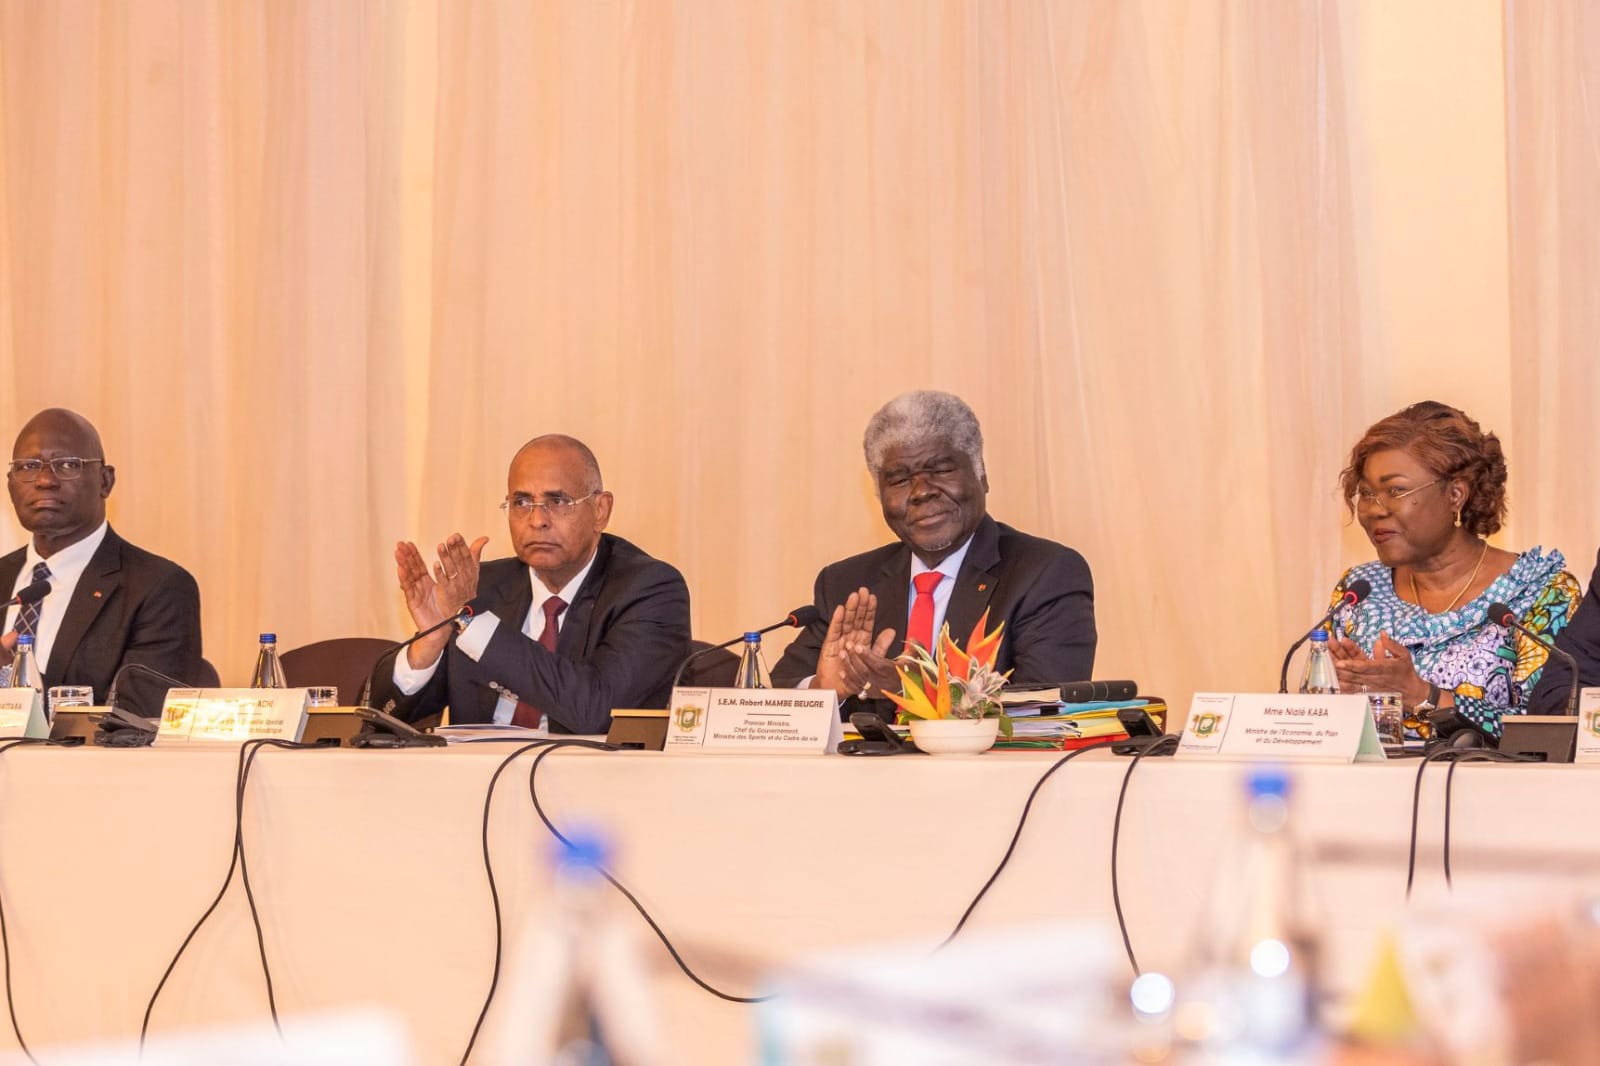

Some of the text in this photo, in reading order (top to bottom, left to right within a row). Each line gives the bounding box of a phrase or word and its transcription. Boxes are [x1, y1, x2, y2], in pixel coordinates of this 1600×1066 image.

[717, 698, 824, 708] S.E.M. Robert MAMBE BEUGRE
[1264, 707, 1283, 716] Mme
[1307, 708, 1329, 717] KABA
[744, 719, 765, 727] Premier
[1325, 729, 1338, 737] Plan
[1272, 737, 1322, 745] Développement
